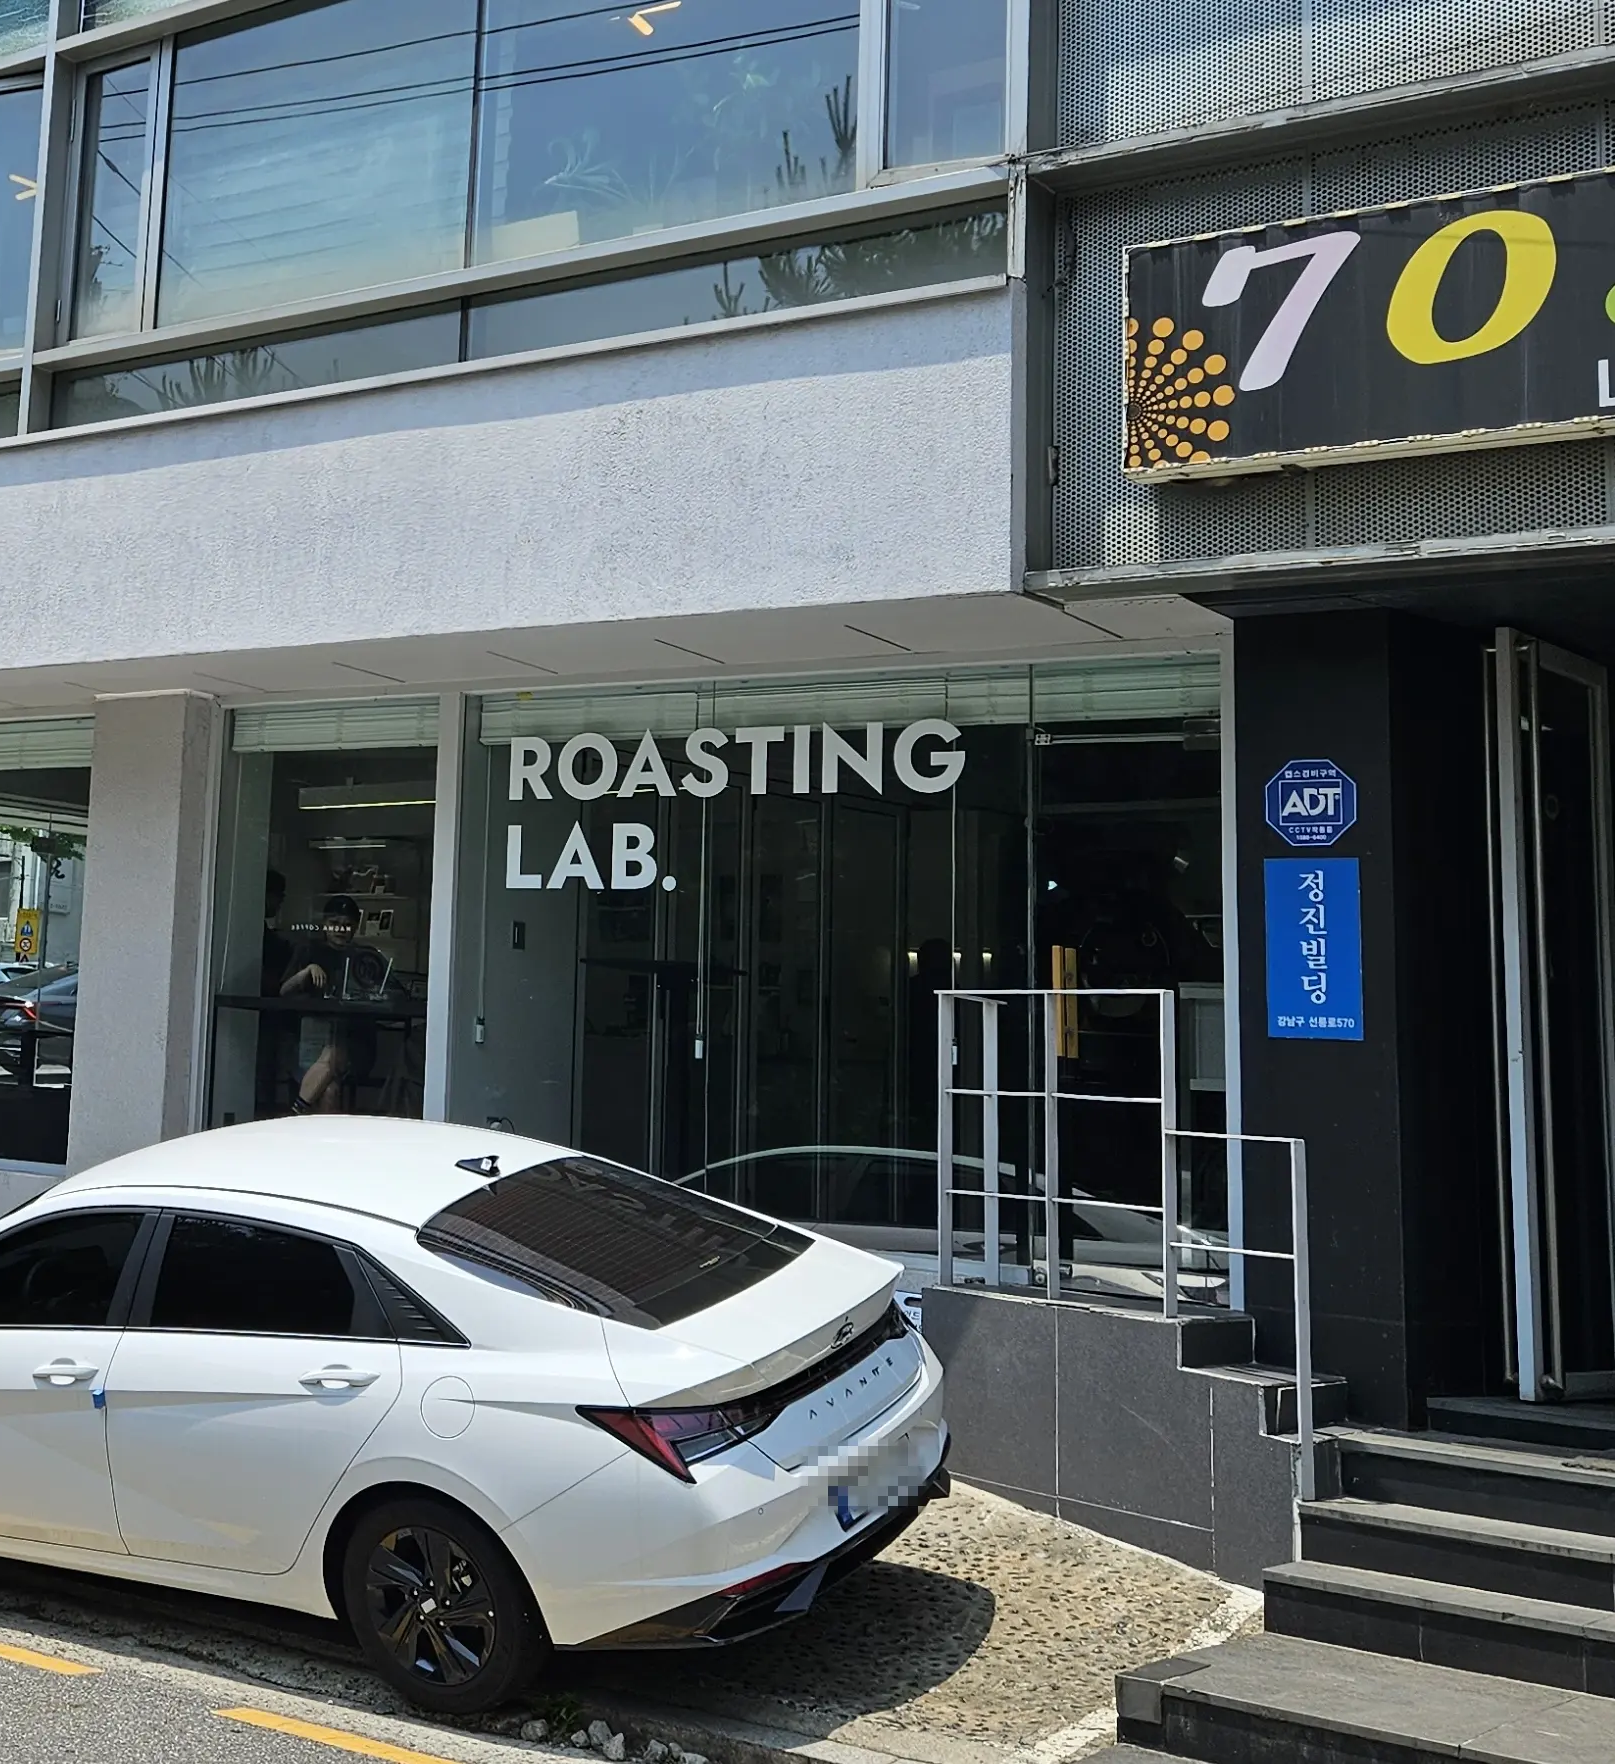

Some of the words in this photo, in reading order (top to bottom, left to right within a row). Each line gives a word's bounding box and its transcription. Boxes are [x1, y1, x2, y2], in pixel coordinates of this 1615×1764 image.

[508, 718, 966, 801] ROASTING
[1282, 788, 1341, 816] ADT
[505, 820, 677, 892] LAB.
[1297, 869, 1329, 1005] 정진빌딩
[1277, 1016, 1305, 1028] 강남구
[808, 1356, 894, 1420] AVANTE
